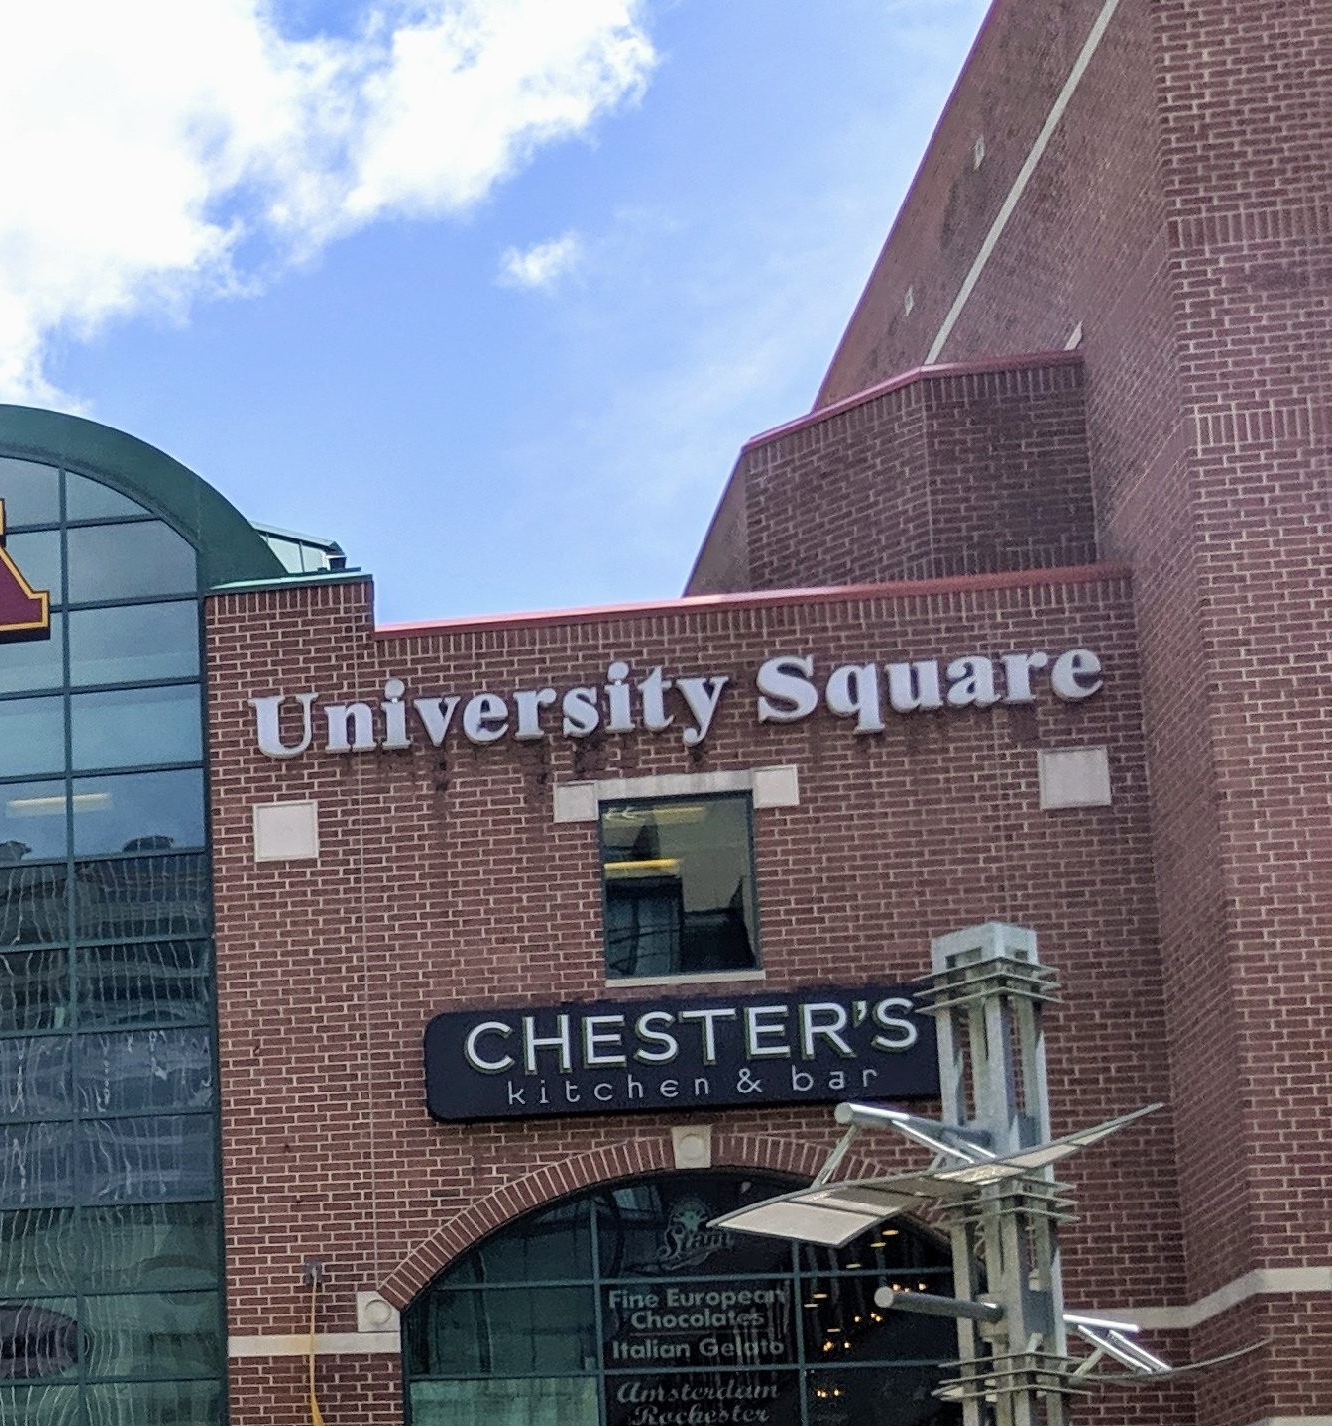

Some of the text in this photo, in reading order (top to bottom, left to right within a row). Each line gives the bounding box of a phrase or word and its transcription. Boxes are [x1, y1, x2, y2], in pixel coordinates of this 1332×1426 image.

[248, 648, 1106, 760] University Square
[465, 997, 919, 1074] CHESTER'S
[507, 1064, 880, 1105] kitchen & bar
[608, 1287, 786, 1310] Fine European
[631, 1308, 765, 1329] Chocolates
[612, 1336, 784, 1360] Italian Gelato
[616, 1379, 779, 1403] Amsterdam
[631, 1403, 771, 1426] Rochester
